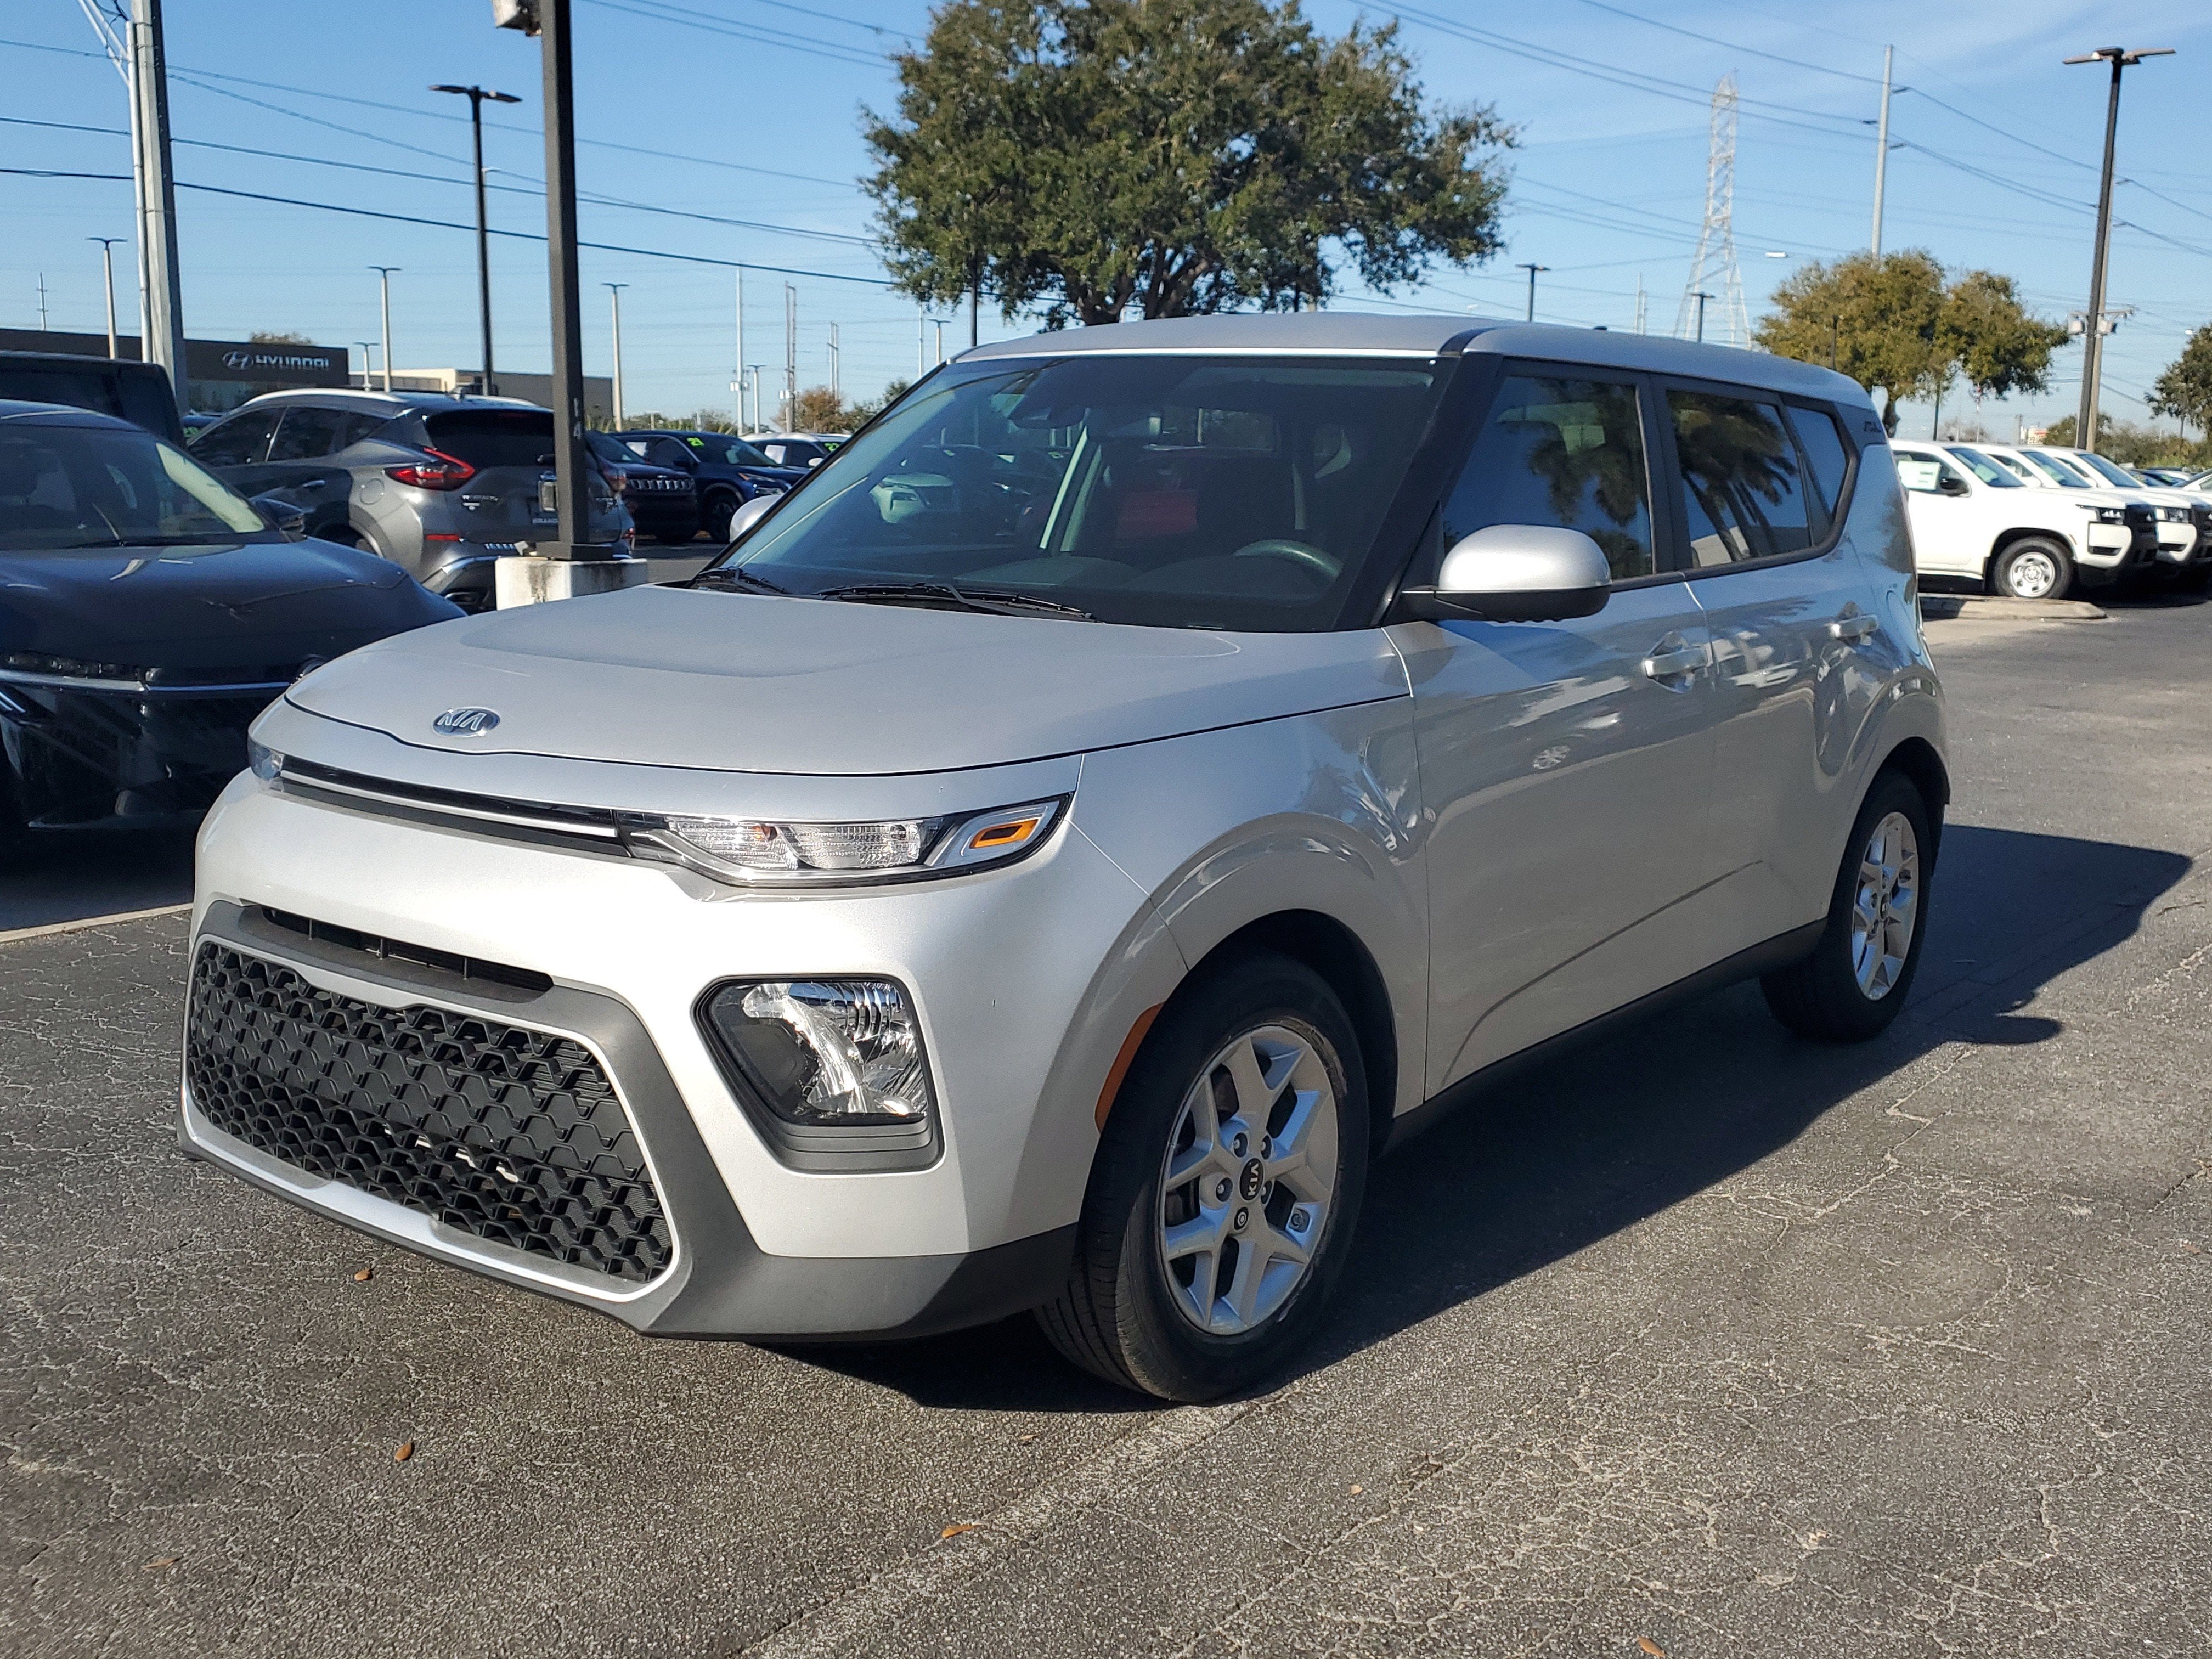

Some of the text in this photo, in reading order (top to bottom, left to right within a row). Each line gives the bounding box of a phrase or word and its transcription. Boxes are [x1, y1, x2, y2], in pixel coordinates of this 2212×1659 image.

[255, 354, 330, 371] HYUNDAI
[437, 709, 487, 731] KIA
[1248, 1163, 1259, 1196] KIA
